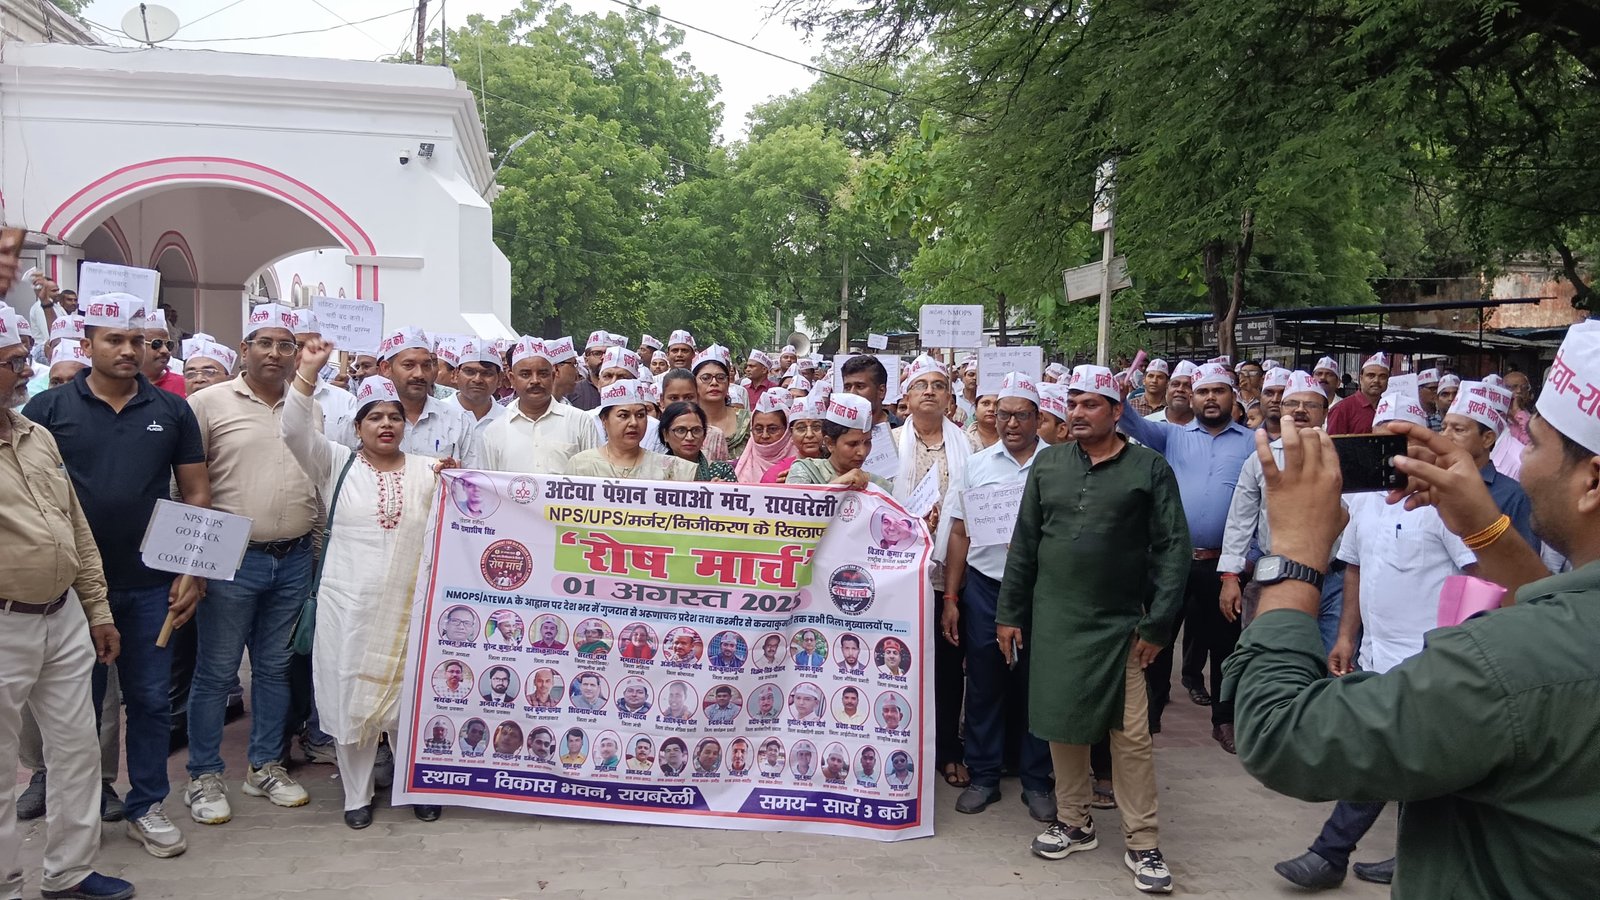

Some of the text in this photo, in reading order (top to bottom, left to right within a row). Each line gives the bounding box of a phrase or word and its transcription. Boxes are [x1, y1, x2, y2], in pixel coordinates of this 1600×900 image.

[1466, 400, 1487, 415] पुरानी
[545, 477, 838, 517] अटेवा पेंशन बचाओ मंच, रायबरेली
[183, 513, 224, 529] NPS UPS
[753, 521, 770, 535] के
[176, 526, 220, 542] GO BACK
[184, 543, 204, 554] OPS
[868, 546, 902, 559] विजय कुमार
[158, 552, 217, 571] COME BACK
[563, 577, 596, 597] 01
[611, 582, 732, 608] अगस्त
[446, 590, 513, 605] NMOPS/ATEWA
[515, 595, 523, 605] के
[551, 600, 562, 610] पर
[564, 600, 577, 611] देश
[578, 603, 590, 613] भर
[601, 605, 628, 617] गुजरात
[630, 606, 638, 617] से
[678, 612, 697, 623] प्रदेश
[699, 614, 714, 625] तथा
[716, 615, 743, 627] कश्मीर
[745, 617, 752, 627] से
[794, 614, 807, 624] तक
[808, 613, 825, 625] सभी
[827, 614, 844, 627] जिला
[883, 622, 893, 632] पर
[422, 770, 472, 786] स्थान
[494, 771, 557, 793] विकास
[561, 783, 611, 801] भवन,
[618, 787, 696, 805] रायबरेली
[823, 798, 861, 816] सायं
[864, 804, 873, 818] 3
[878, 803, 909, 820] बजे
